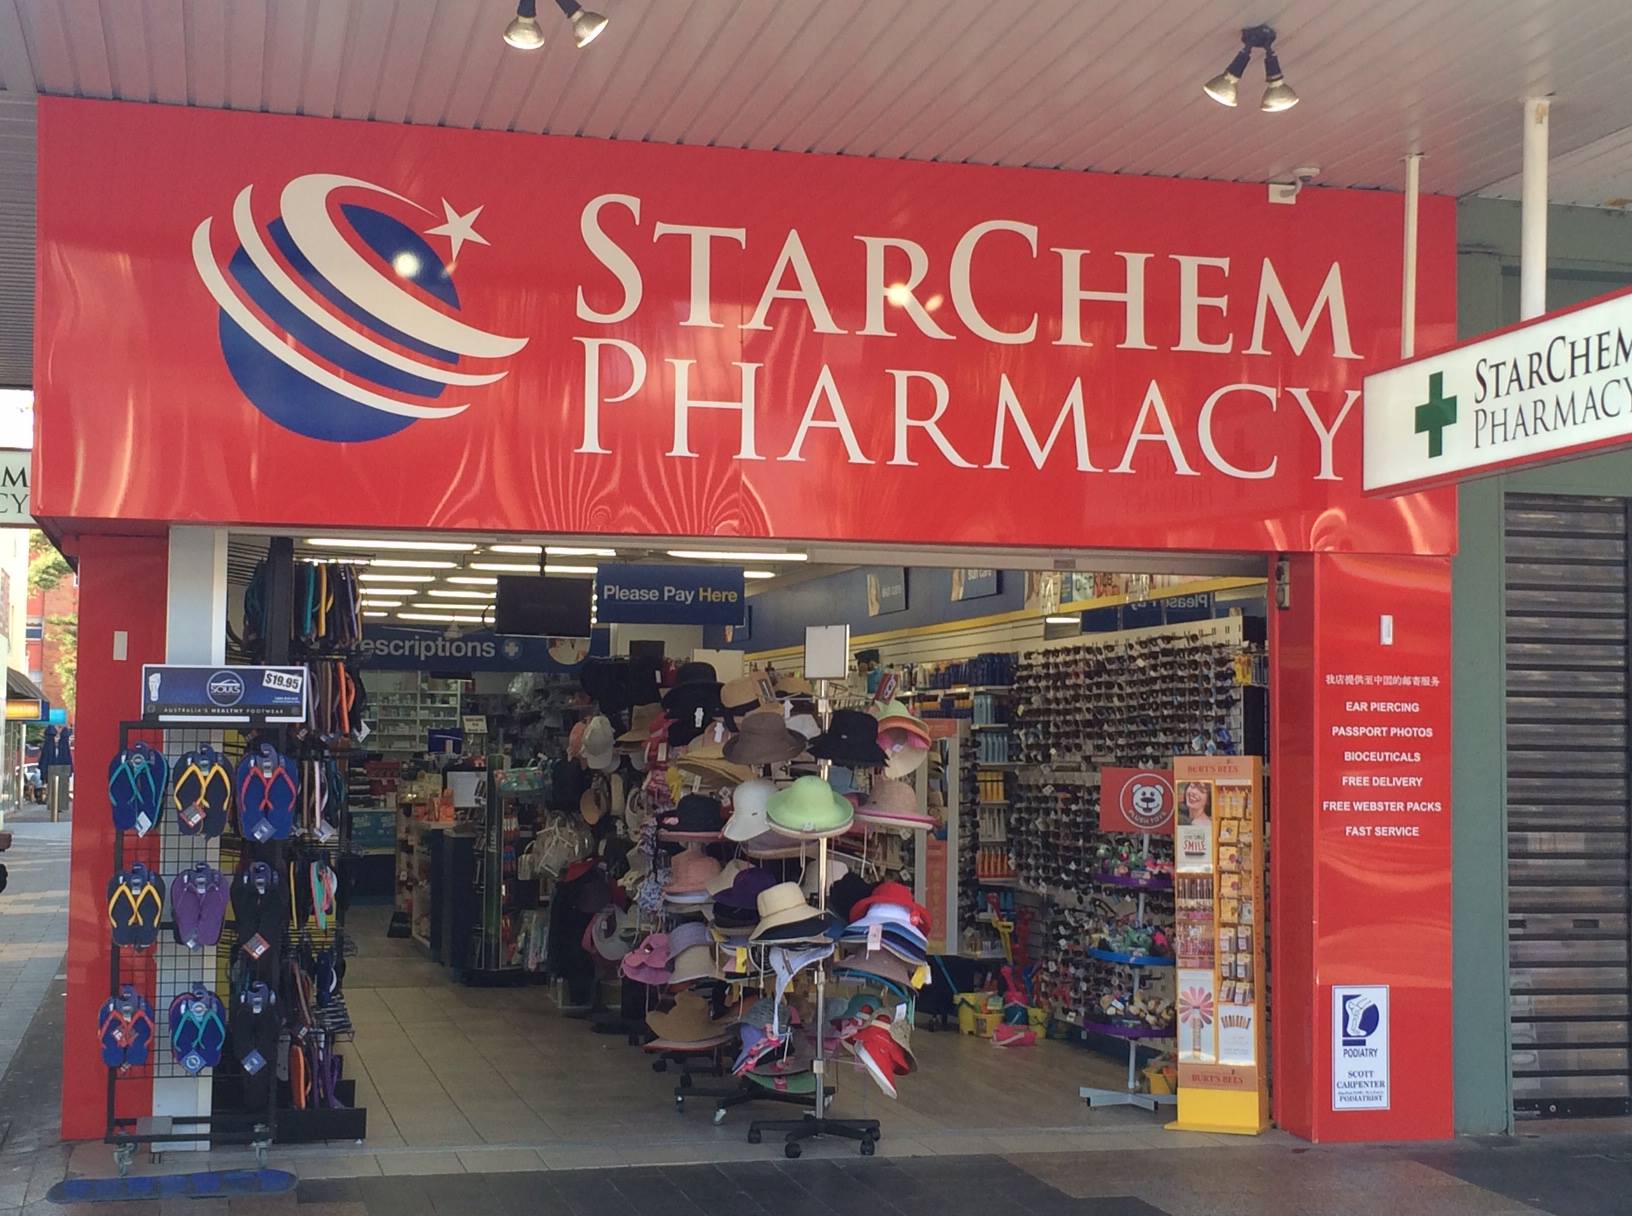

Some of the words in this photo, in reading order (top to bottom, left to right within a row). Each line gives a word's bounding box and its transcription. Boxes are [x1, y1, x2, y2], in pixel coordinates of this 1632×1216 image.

[575, 194, 1364, 359] STARCHEM
[573, 337, 1363, 481] PHARMACY
[603, 585, 660, 600] Please
[663, 586, 695, 605] Pay
[698, 587, 738, 602] Here
[265, 672, 300, 690] $19.95
[1345, 701, 1368, 712] EAR
[1370, 702, 1420, 713] PIERCING
[1331, 726, 1389, 737] PASSPORT
[1390, 727, 1434, 738] PHOTOS
[1343, 751, 1421, 762] BIOCEUTICALS
[1341, 776, 1371, 787] FREE
[1372, 776, 1424, 787] DELIVERY
[1322, 801, 1351, 812] FREE
[1352, 801, 1405, 812] WEBSTER
[1406, 801, 1442, 812] PACKS
[1345, 826, 1372, 837] FAST
[1374, 826, 1420, 837] SERVICE
[1183, 839, 1207, 851] SMILE
[1342, 1048, 1378, 1058] PODIATRY
[1347, 1070, 1375, 1079] SCOTT
[1336, 1080, 1386, 1089] CARPENTER
